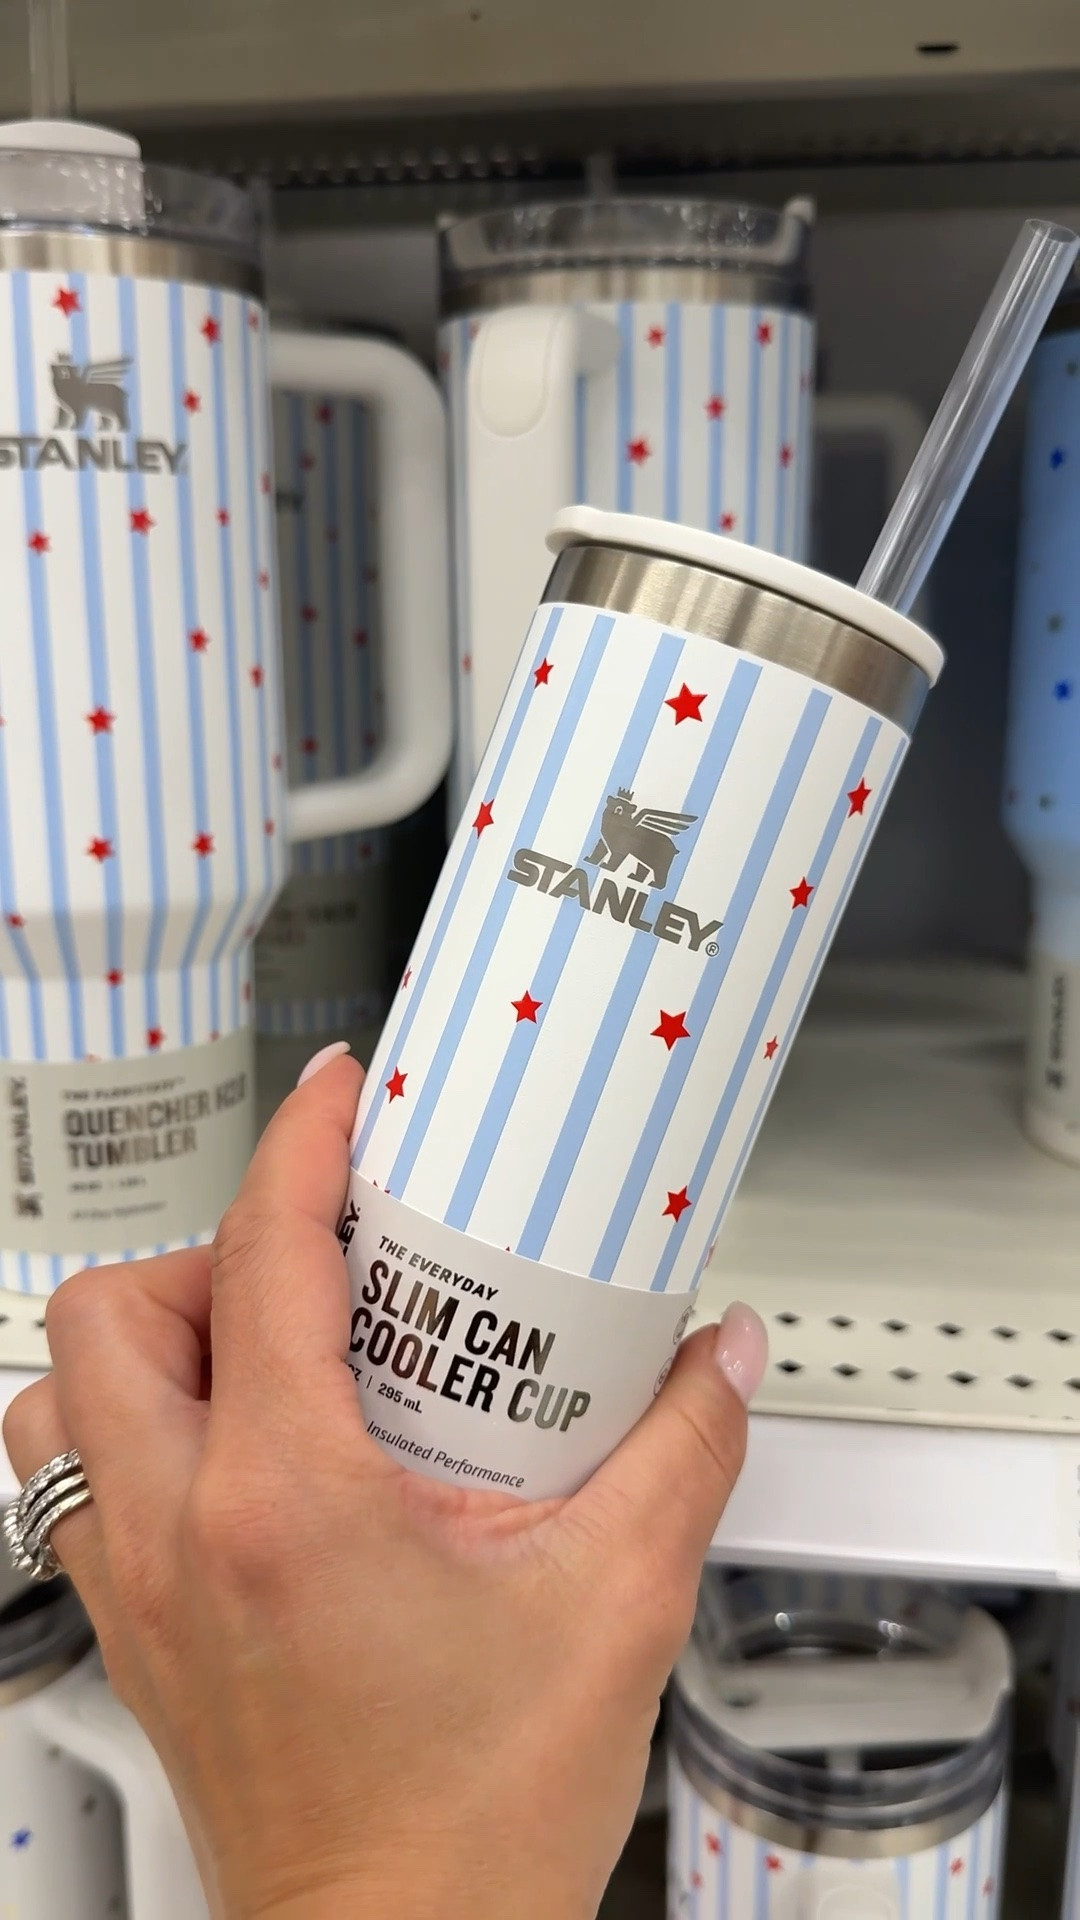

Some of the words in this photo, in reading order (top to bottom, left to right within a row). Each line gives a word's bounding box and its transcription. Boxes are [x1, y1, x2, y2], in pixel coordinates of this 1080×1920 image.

[64, 1089, 211, 1137] QUENCHER
[67, 1126, 199, 1169] TUMBLER
[379, 1235, 408, 1260] THE
[408, 1252, 499, 1301] EVERYDAY
[361, 1259, 460, 1342] SLIM
[464, 1309, 556, 1375] CAN
[349, 1307, 501, 1413] COOLER
[506, 1378, 591, 1433] CUP
[377, 1382, 403, 1404] 295
[403, 1397, 423, 1414] mL
[366, 1420, 434, 1460] Insulated
[433, 1450, 525, 1488] Performance
